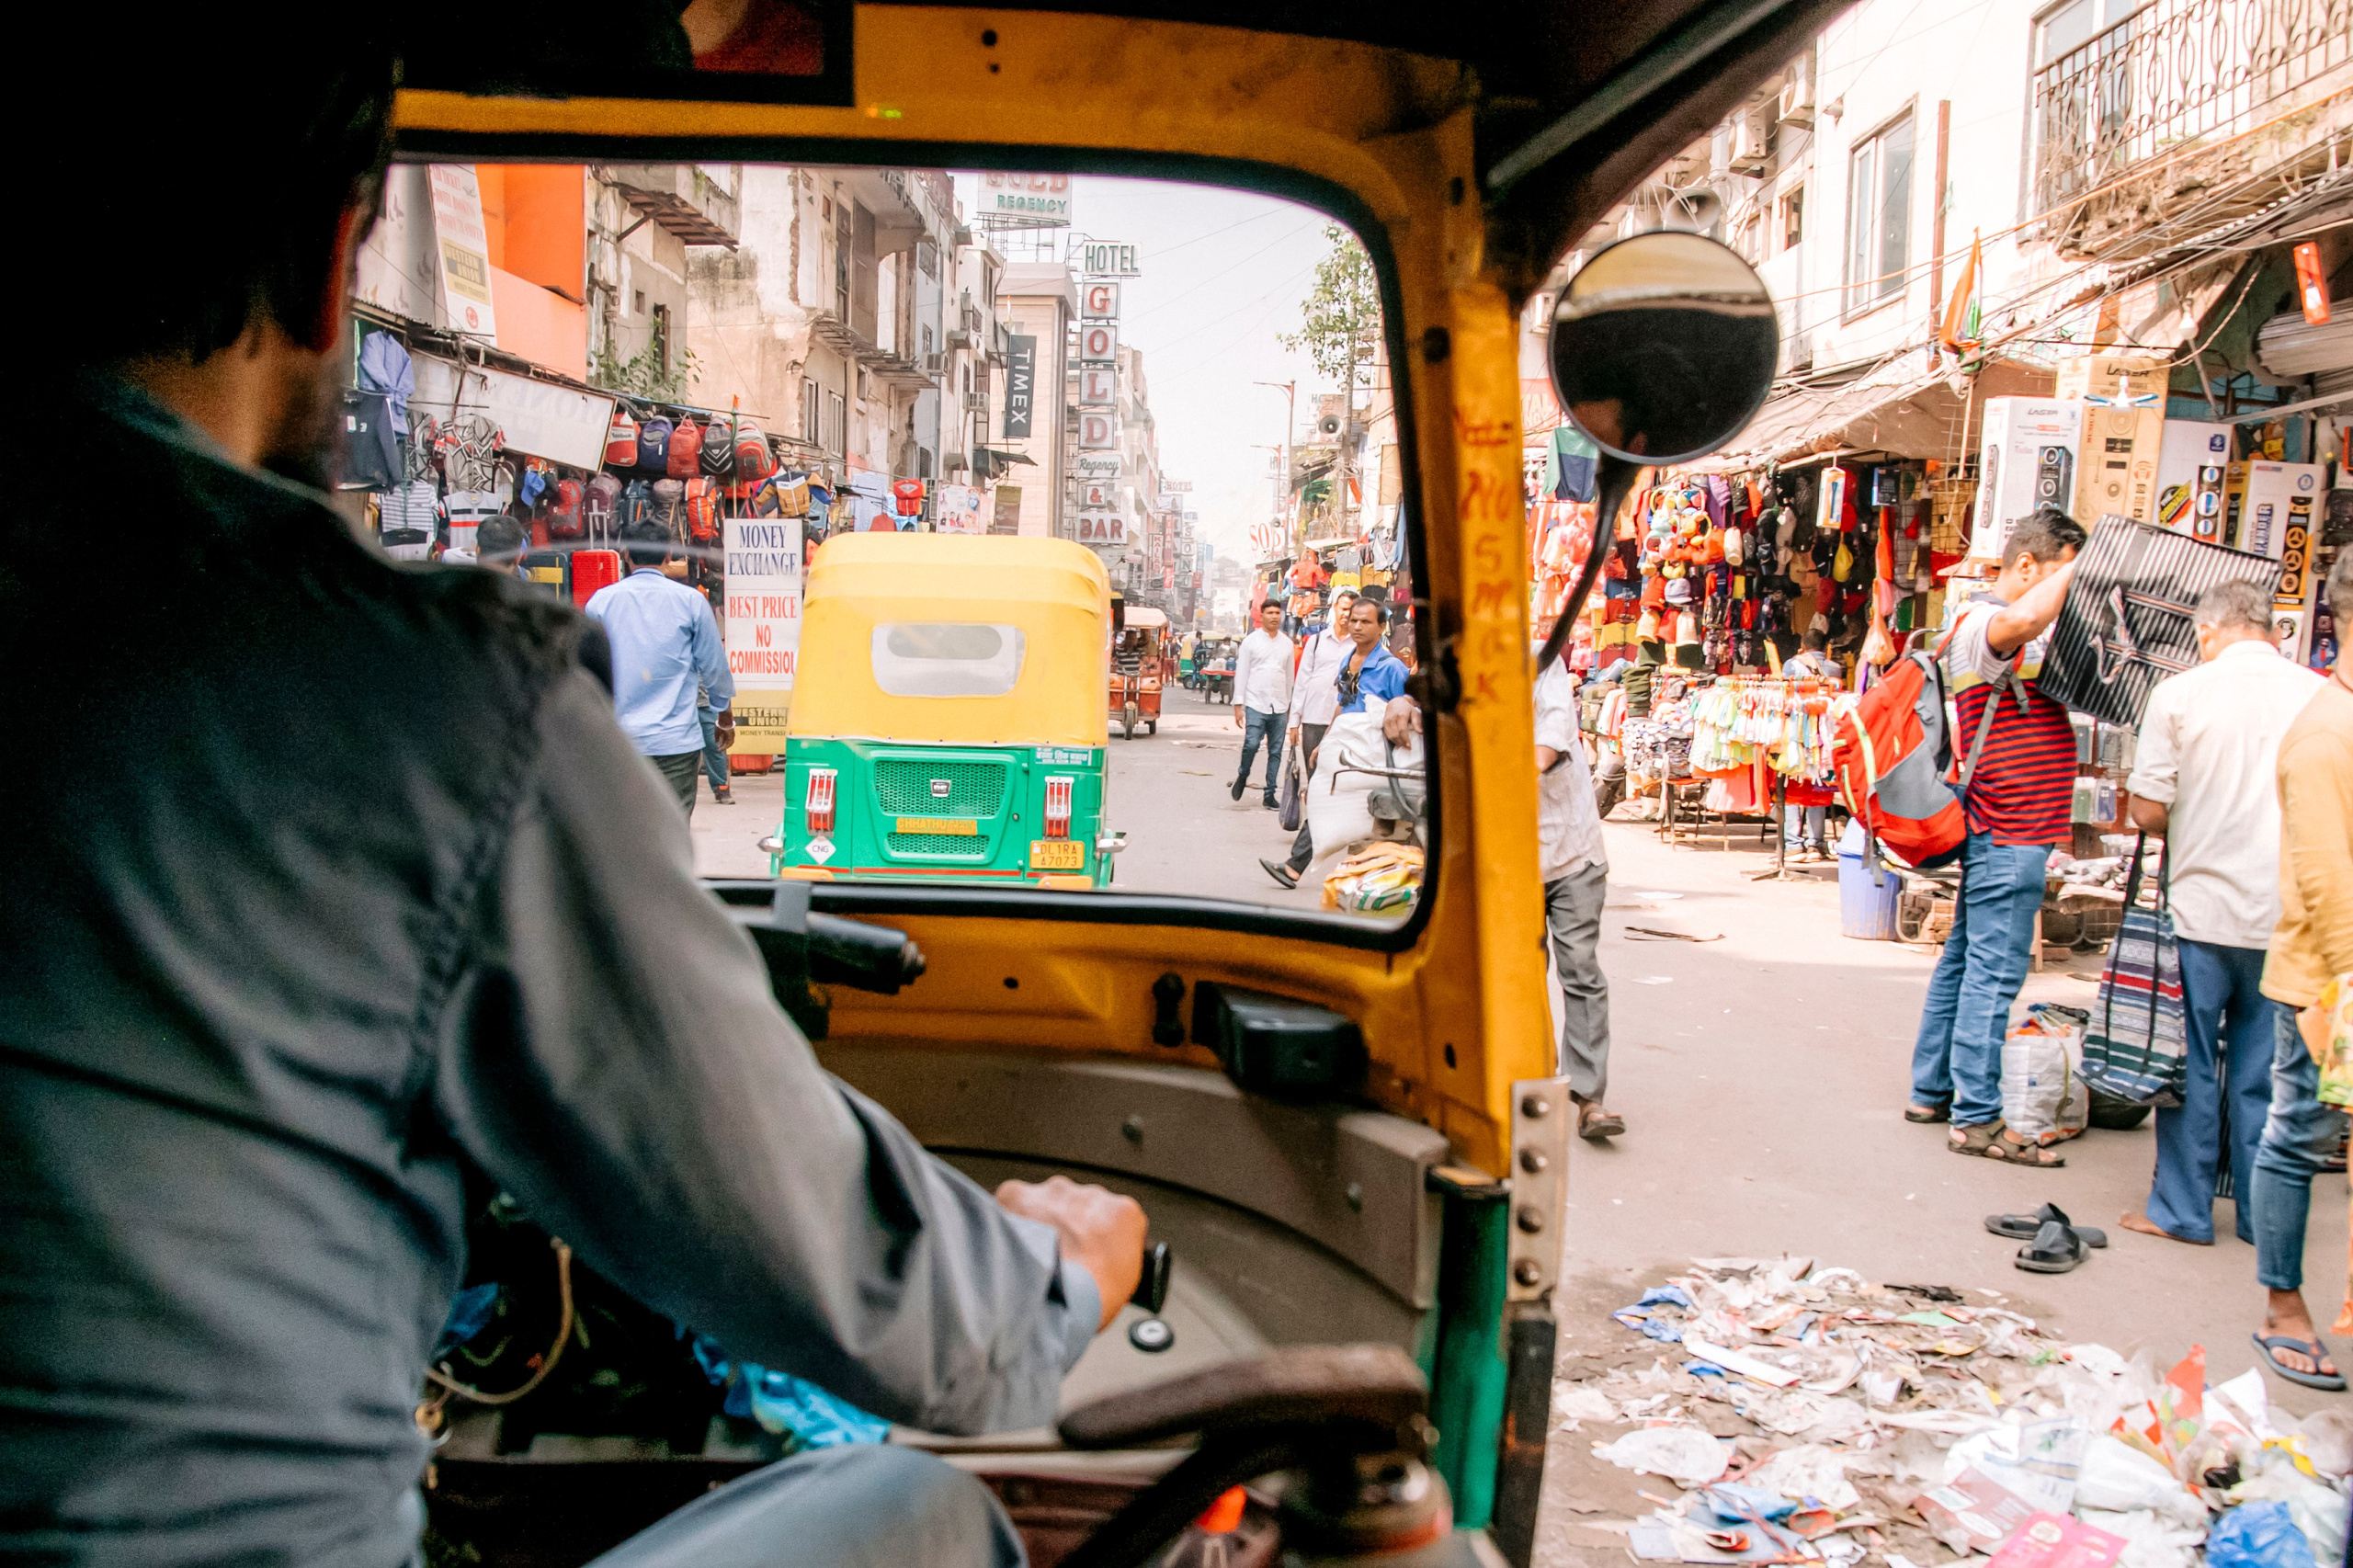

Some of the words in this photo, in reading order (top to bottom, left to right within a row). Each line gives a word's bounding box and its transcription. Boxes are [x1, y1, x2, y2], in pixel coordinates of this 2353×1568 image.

[997, 194, 1067, 214] REGENCY
[1085, 244, 1139, 273] HOTEL
[1086, 286, 1110, 444] GOLD
[1011, 348, 1031, 424] TIMEX
[1079, 458, 1120, 476] Regency
[1089, 487, 1103, 504] &
[1165, 481, 1193, 492] HOTEL
[739, 525, 787, 549] MONEY
[1079, 518, 1123, 539] BAR
[729, 552, 797, 575] EXCHANGE
[729, 596, 758, 619] BEST
[762, 596, 797, 619] PRICE
[756, 624, 771, 648] NO
[732, 708, 787, 717] WESTERN
[748, 717, 787, 726] UNION
[812, 845, 829, 853] CNG
[1040, 856, 1077, 867] A7073
